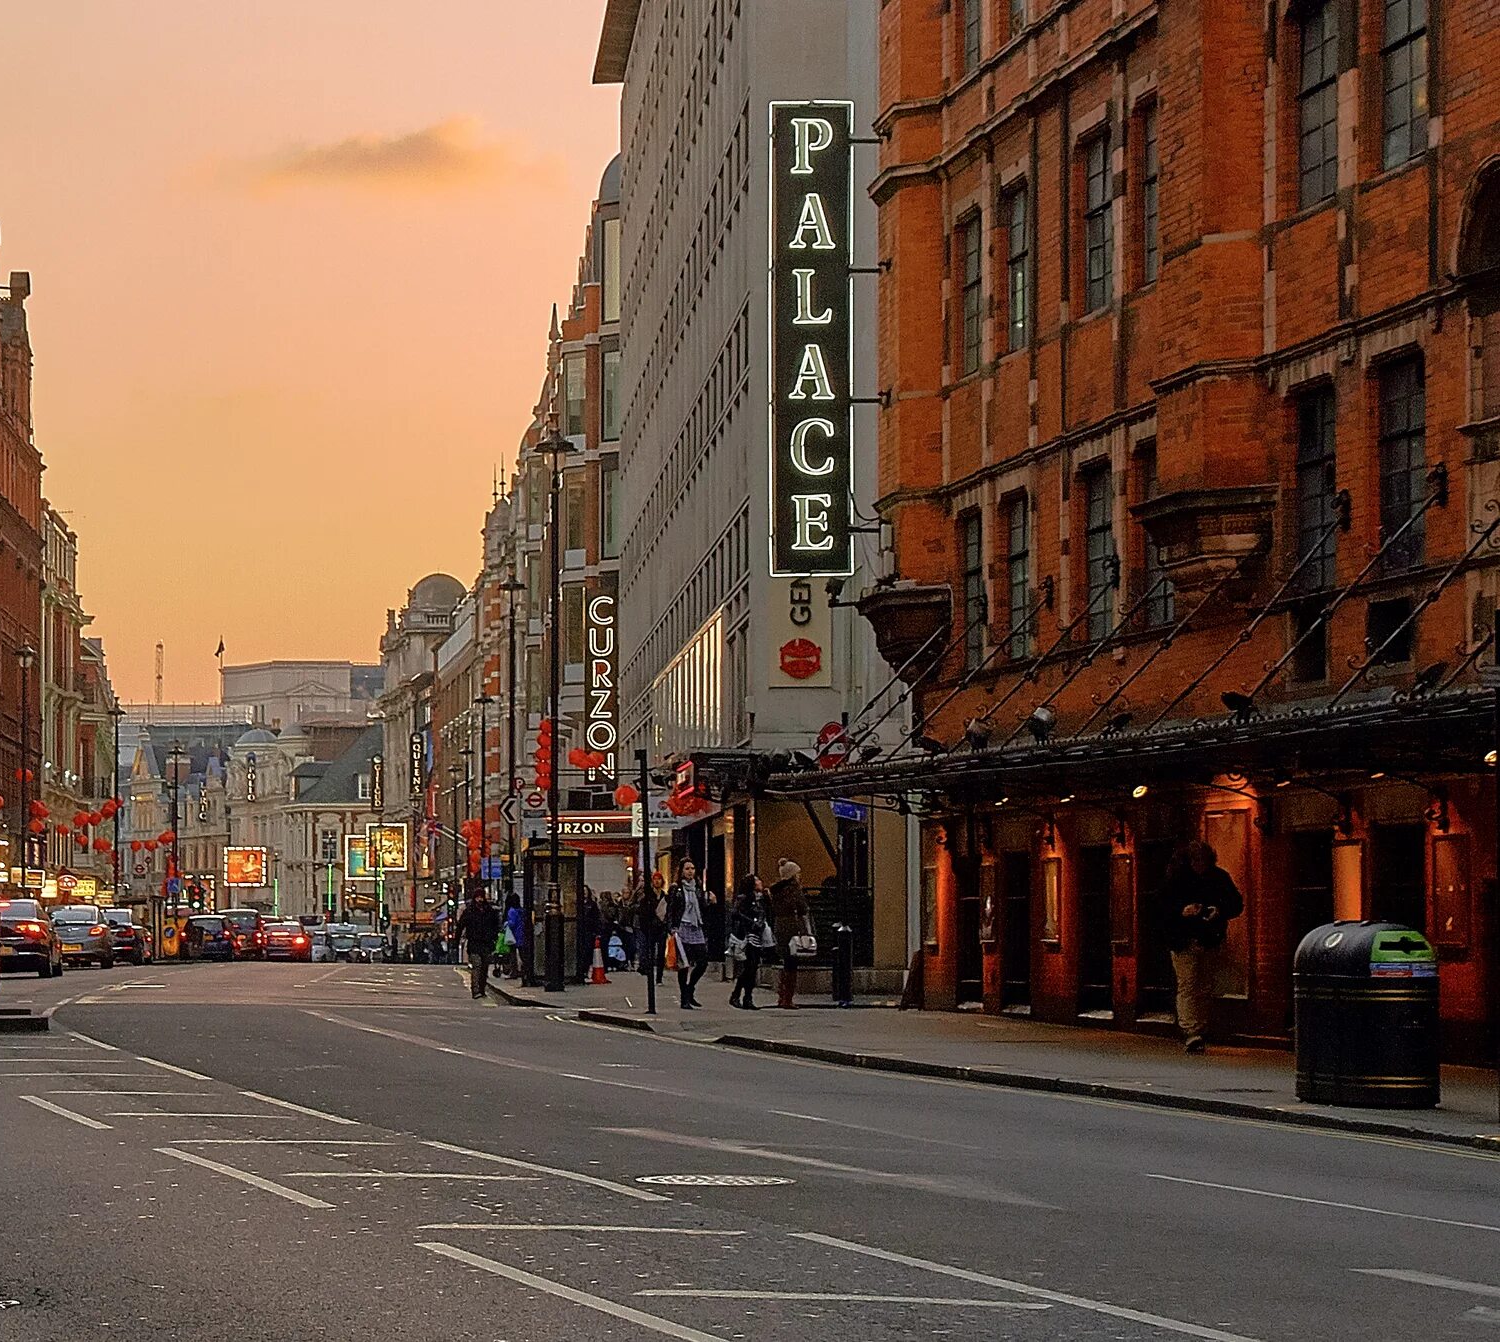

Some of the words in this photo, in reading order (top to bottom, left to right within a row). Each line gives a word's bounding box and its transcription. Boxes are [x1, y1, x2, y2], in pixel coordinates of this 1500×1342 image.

[788, 117, 836, 551] PALACE
[586, 596, 617, 781] CURZON
[198, 781, 207, 820] LYRIC
[413, 744, 421, 793] QUEENS
